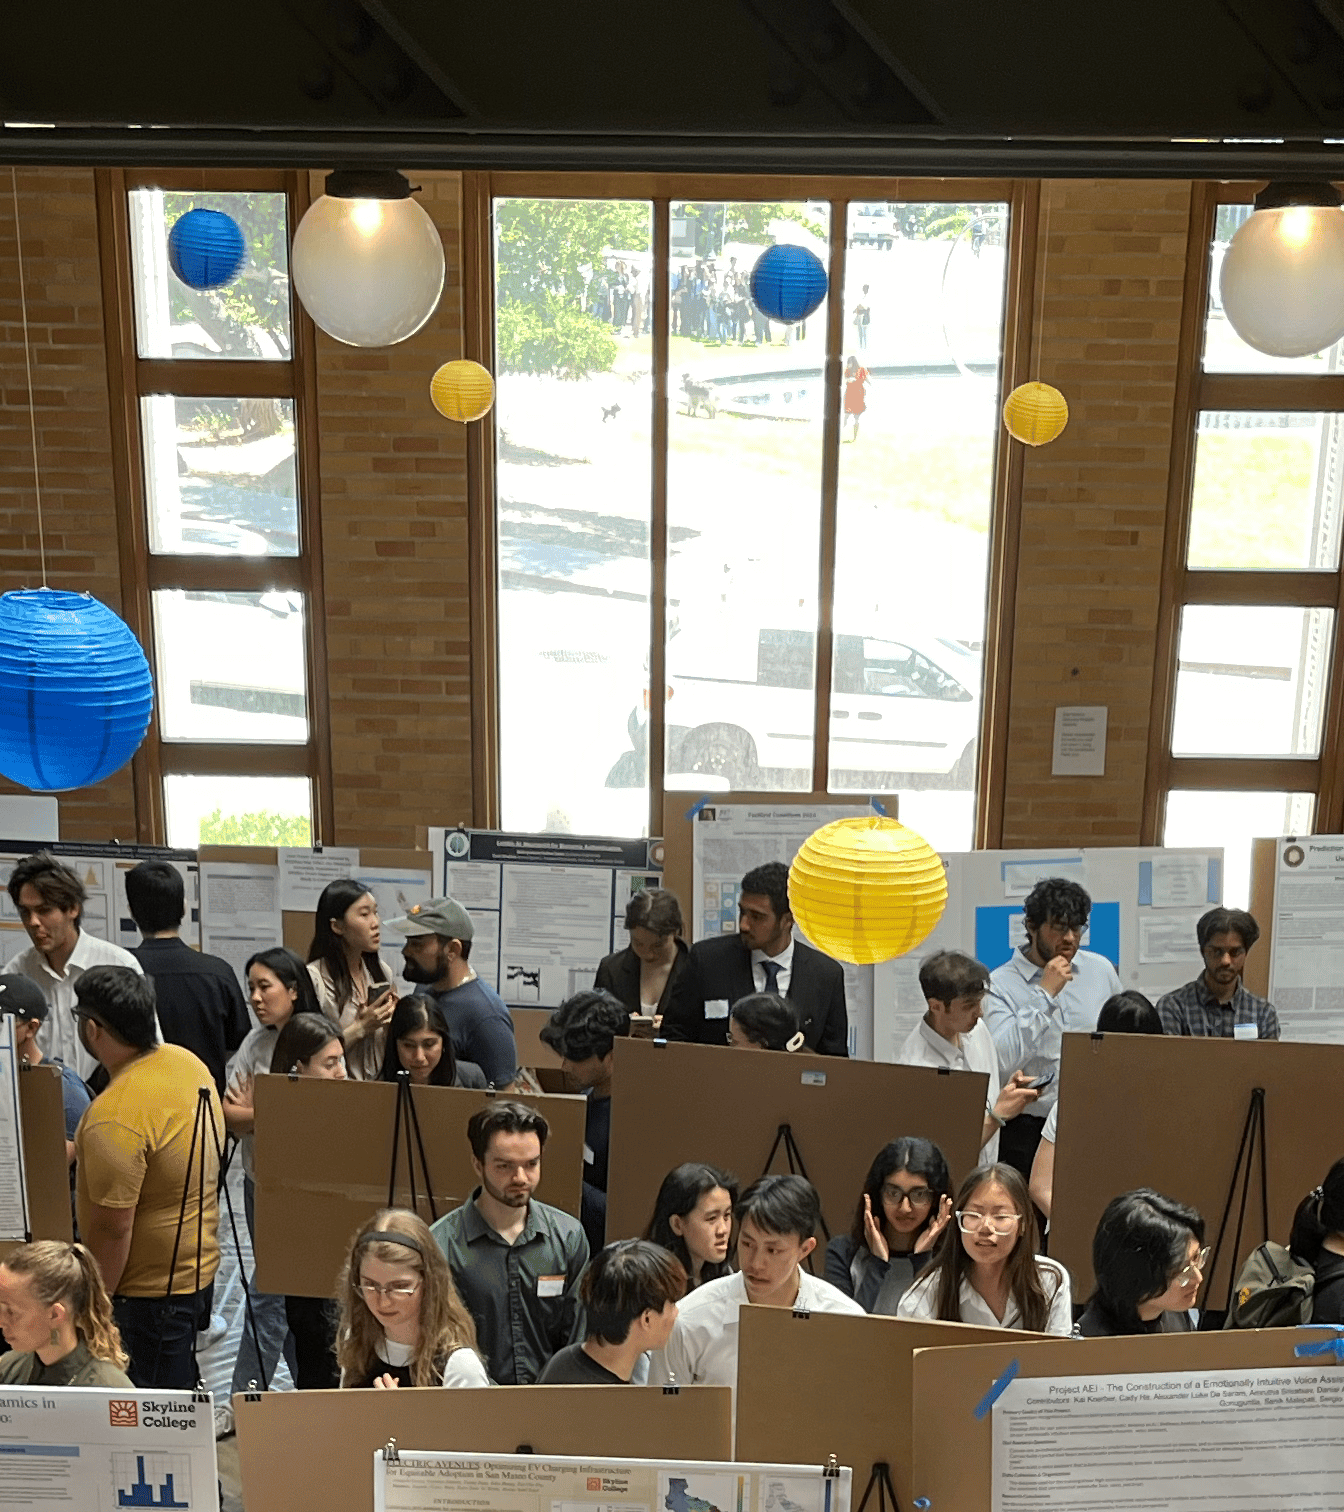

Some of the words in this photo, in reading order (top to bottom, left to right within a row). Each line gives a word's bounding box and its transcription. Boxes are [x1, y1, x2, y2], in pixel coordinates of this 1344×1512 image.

[1049, 1384, 1080, 1395] Project
[1107, 1383, 1123, 1392] The
[1126, 1381, 1181, 1391] Construction
[1184, 1380, 1193, 1389] of
[1203, 1378, 1254, 1390] Emotionally
[1257, 1377, 1291, 1387] Intuitive
[1293, 1376, 1317, 1385] Voice
[43, 1397, 56, 1408] in
[142, 1402, 195, 1413] Skyline
[142, 1417, 196, 1430] College
[386, 1468, 397, 1476] for
[437, 1470, 475, 1478] Adoption
[485, 1471, 500, 1479] San
[502, 1471, 526, 1479] Mateo
[528, 1472, 556, 1482] County
[483, 1463, 526, 1471] Optimizing
[543, 1464, 577, 1474] Charging
[580, 1465, 631, 1475] Infrastructure
